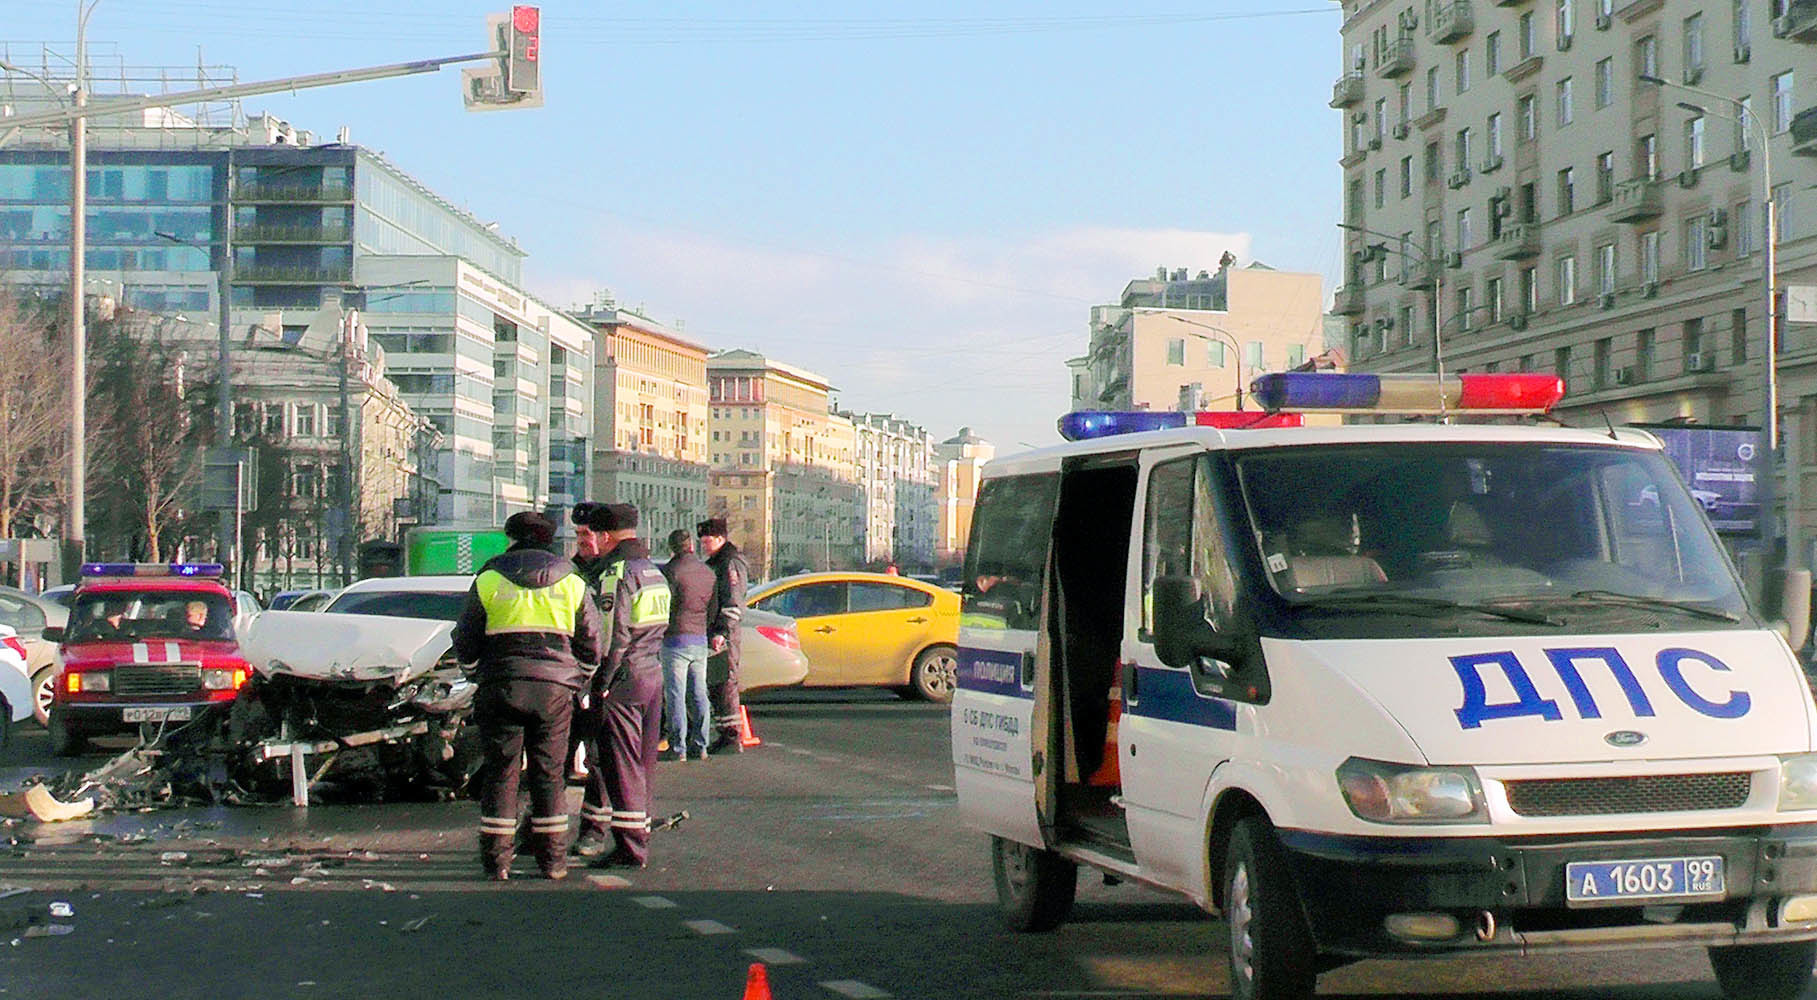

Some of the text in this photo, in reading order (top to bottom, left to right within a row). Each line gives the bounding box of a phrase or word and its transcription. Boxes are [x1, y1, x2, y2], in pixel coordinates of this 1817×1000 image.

[974, 661, 1015, 683] ПОЛИЦИЯ
[1447, 647, 1751, 730] ДПС
[1610, 864, 1674, 893] 1603
[1688, 860, 1714, 882] 99
[1692, 881, 1712, 891] RUS
